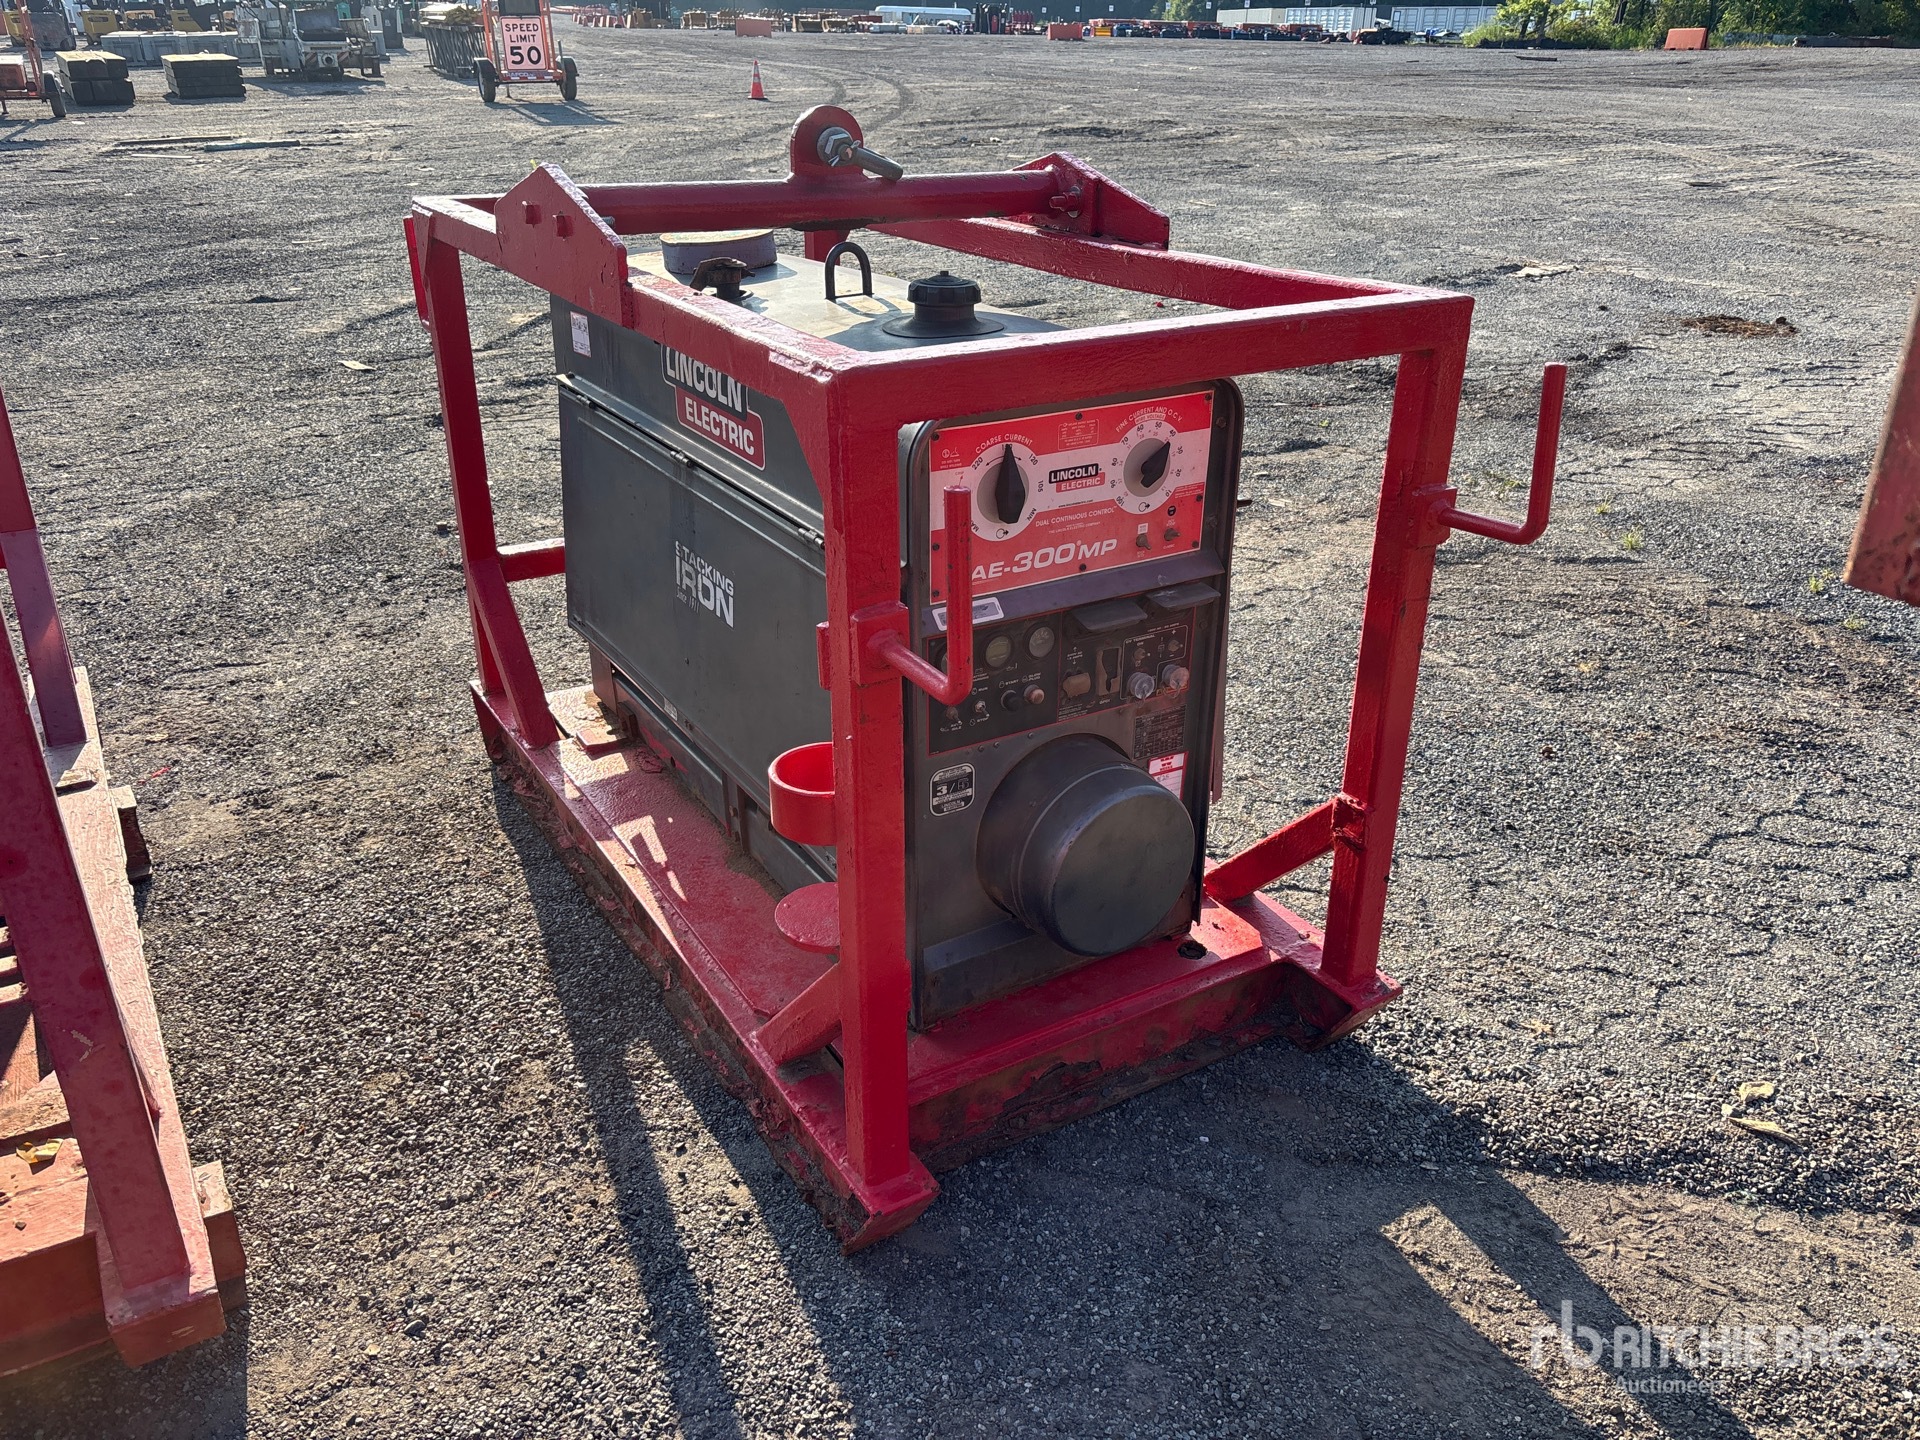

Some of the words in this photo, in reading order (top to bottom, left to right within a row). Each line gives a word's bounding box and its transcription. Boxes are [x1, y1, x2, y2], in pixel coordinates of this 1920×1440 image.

[505, 23, 539, 32] SPEED
[509, 34, 536, 43] LIMIT
[510, 46, 541, 65] 50
[666, 346, 742, 413] LINCOLN
[1115, 419, 1128, 432] FINE
[1128, 406, 1154, 420] CURRENT
[1155, 406, 1167, 414] AND
[1155, 421, 1162, 429] 50
[685, 396, 755, 456] ELECTRIC
[1136, 424, 1144, 432] 60
[976, 435, 1001, 454] COARSE
[1004, 434, 1033, 446] CURRENT
[1121, 436, 1129, 445] 70
[972, 457, 983, 470] 220
[1028, 454, 1038, 466] 120
[1111, 457, 1118, 466] 80
[1050, 466, 1096, 482] LINCOLN
[1175, 468, 1182, 477] 20
[1061, 478, 1101, 491] ELECTRIC
[1110, 479, 1116, 488] 90
[1027, 507, 1037, 521] MIN
[1035, 518, 1049, 527] DUAL
[1051, 512, 1087, 524] CONTINUOUS
[675, 540, 734, 597] STACKING
[675, 555, 734, 628] IRON
